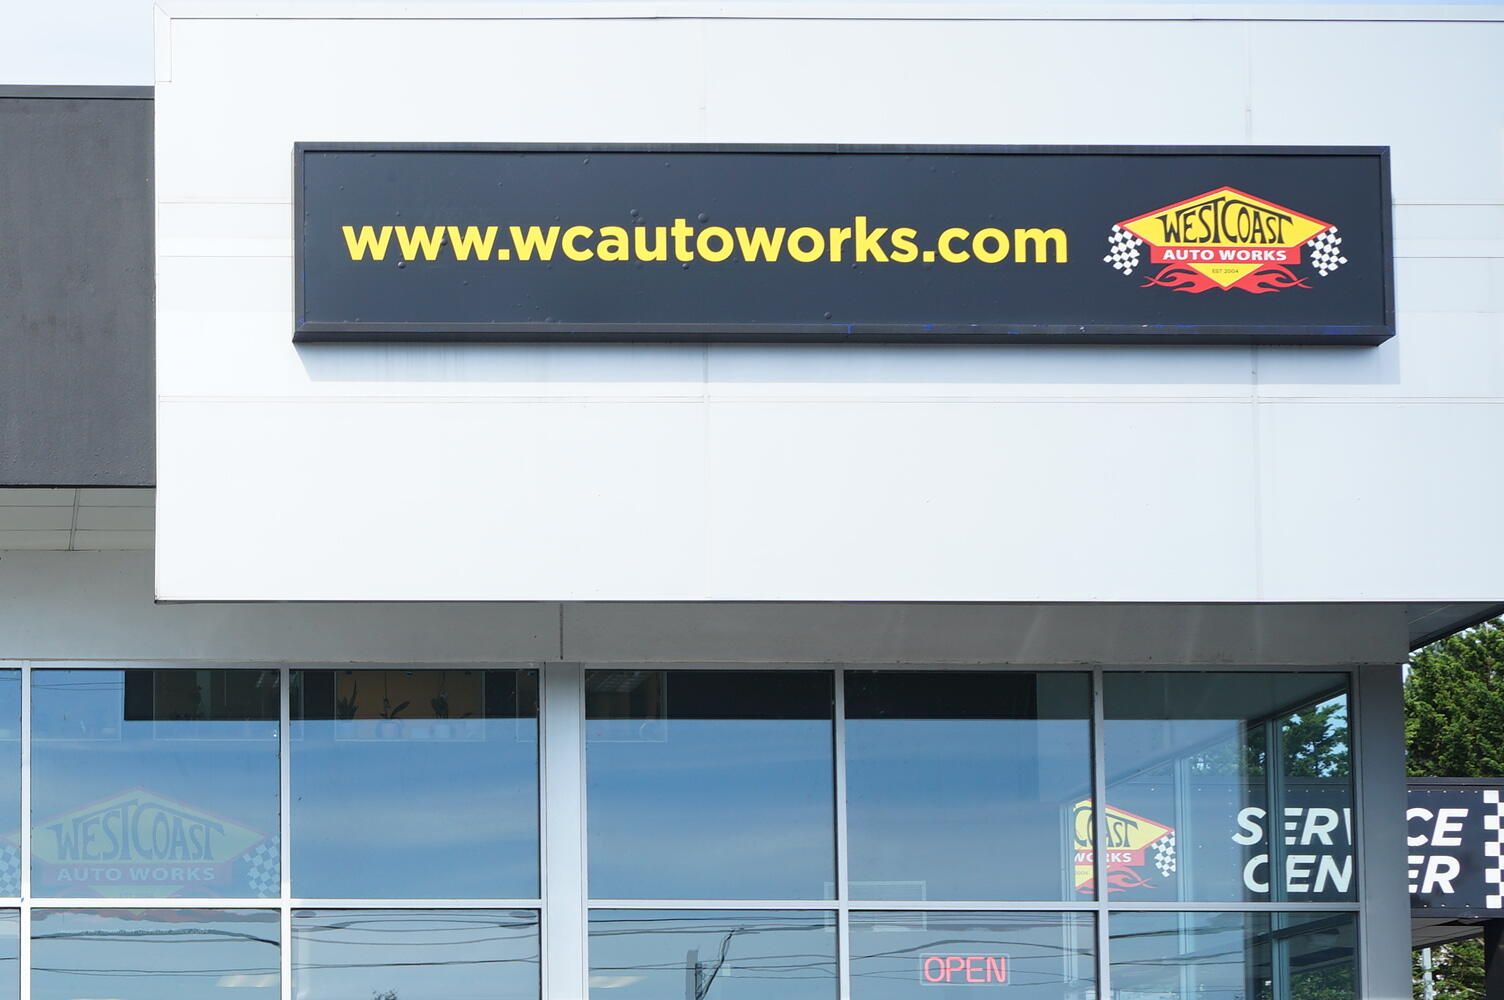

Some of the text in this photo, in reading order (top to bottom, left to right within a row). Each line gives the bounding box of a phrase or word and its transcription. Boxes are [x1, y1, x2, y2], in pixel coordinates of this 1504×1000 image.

[342, 215, 1068, 263] www.wcautoworks.com
[1155, 196, 1293, 244] WESTCOAST
[1162, 250, 1287, 261] AUTO WORKS
[46, 798, 225, 861] WESTCOAST
[1231, 806, 1469, 847] SERCE
[56, 867, 216, 881] AUTO WORKS
[1074, 852, 1132, 863] WKS
[1243, 853, 1461, 894] CENR
[923, 956, 1007, 983] OPEN
